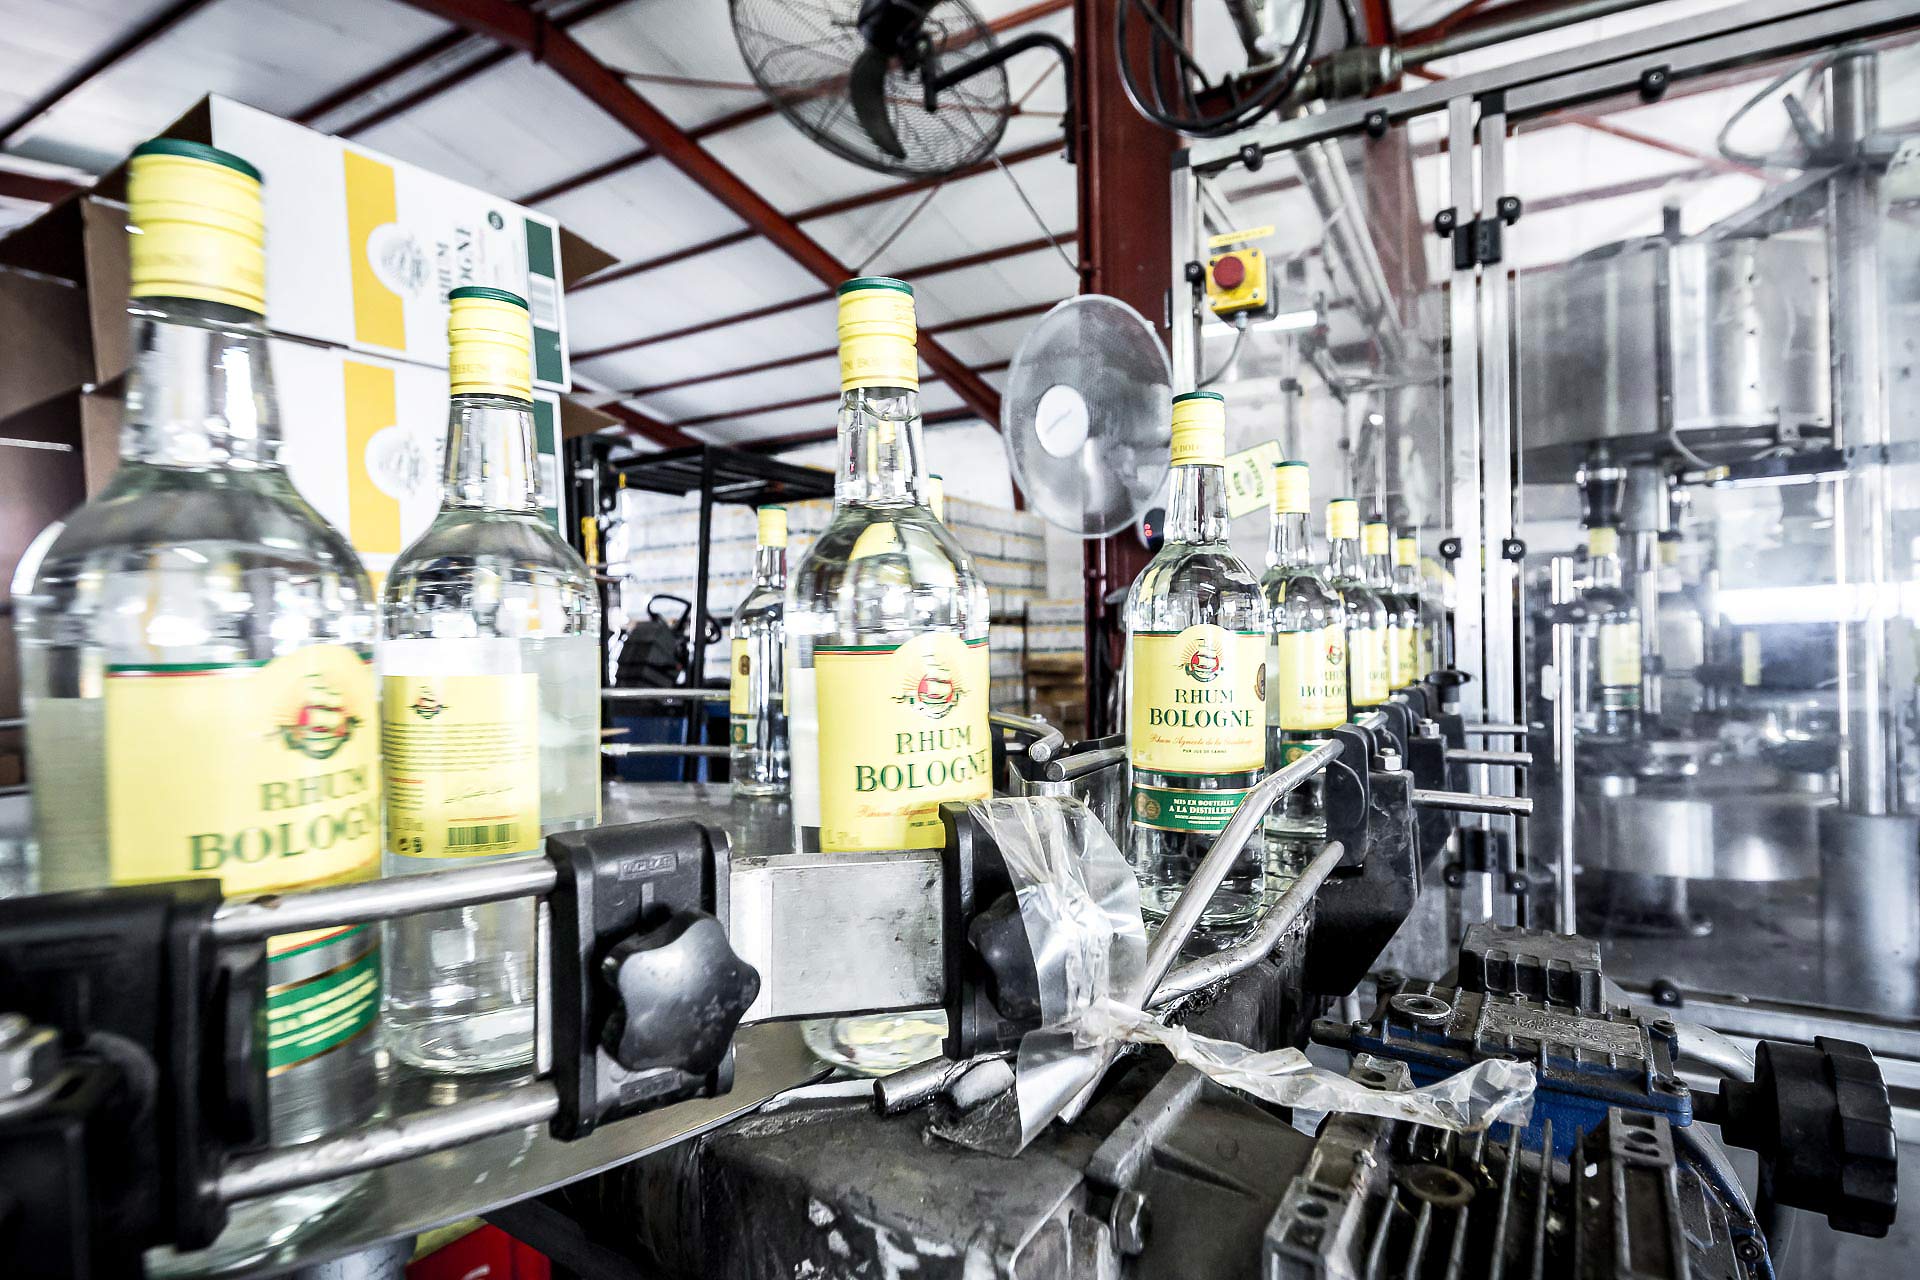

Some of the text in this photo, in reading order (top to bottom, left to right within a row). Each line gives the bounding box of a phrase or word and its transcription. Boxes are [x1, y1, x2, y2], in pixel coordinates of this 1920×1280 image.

[1175, 689, 1233, 704] RHUM
[1149, 707, 1254, 728] BOLOGNE
[895, 725, 972, 755] RHUM
[1173, 798, 1187, 806] MIS
[1197, 799, 1235, 807] BOUTEILLE
[1176, 805, 1188, 813] LA
[187, 803, 376, 871] BOLOG
